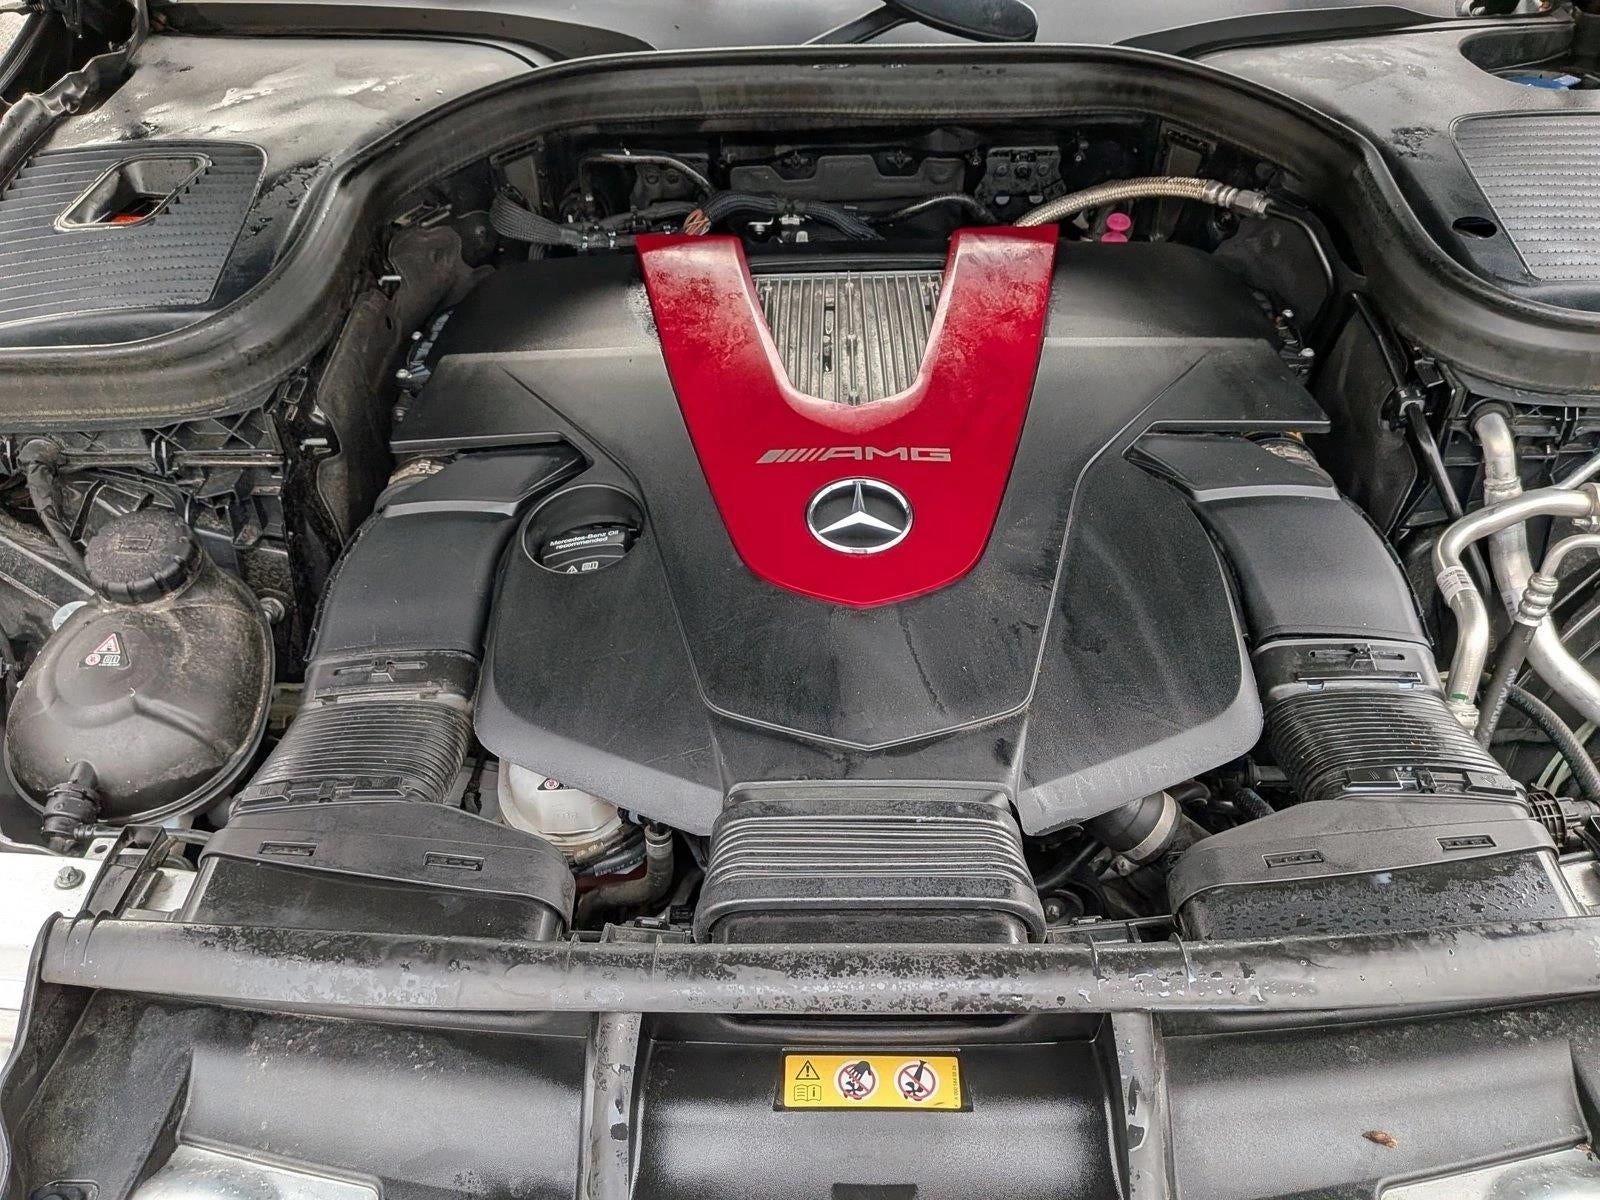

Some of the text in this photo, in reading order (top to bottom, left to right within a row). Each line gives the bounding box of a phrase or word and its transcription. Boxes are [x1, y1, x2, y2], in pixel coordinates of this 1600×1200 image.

[817, 446, 952, 463] AMG
[550, 532, 606, 546] Mercedes-Benz
[556, 536, 608, 550] recommended
